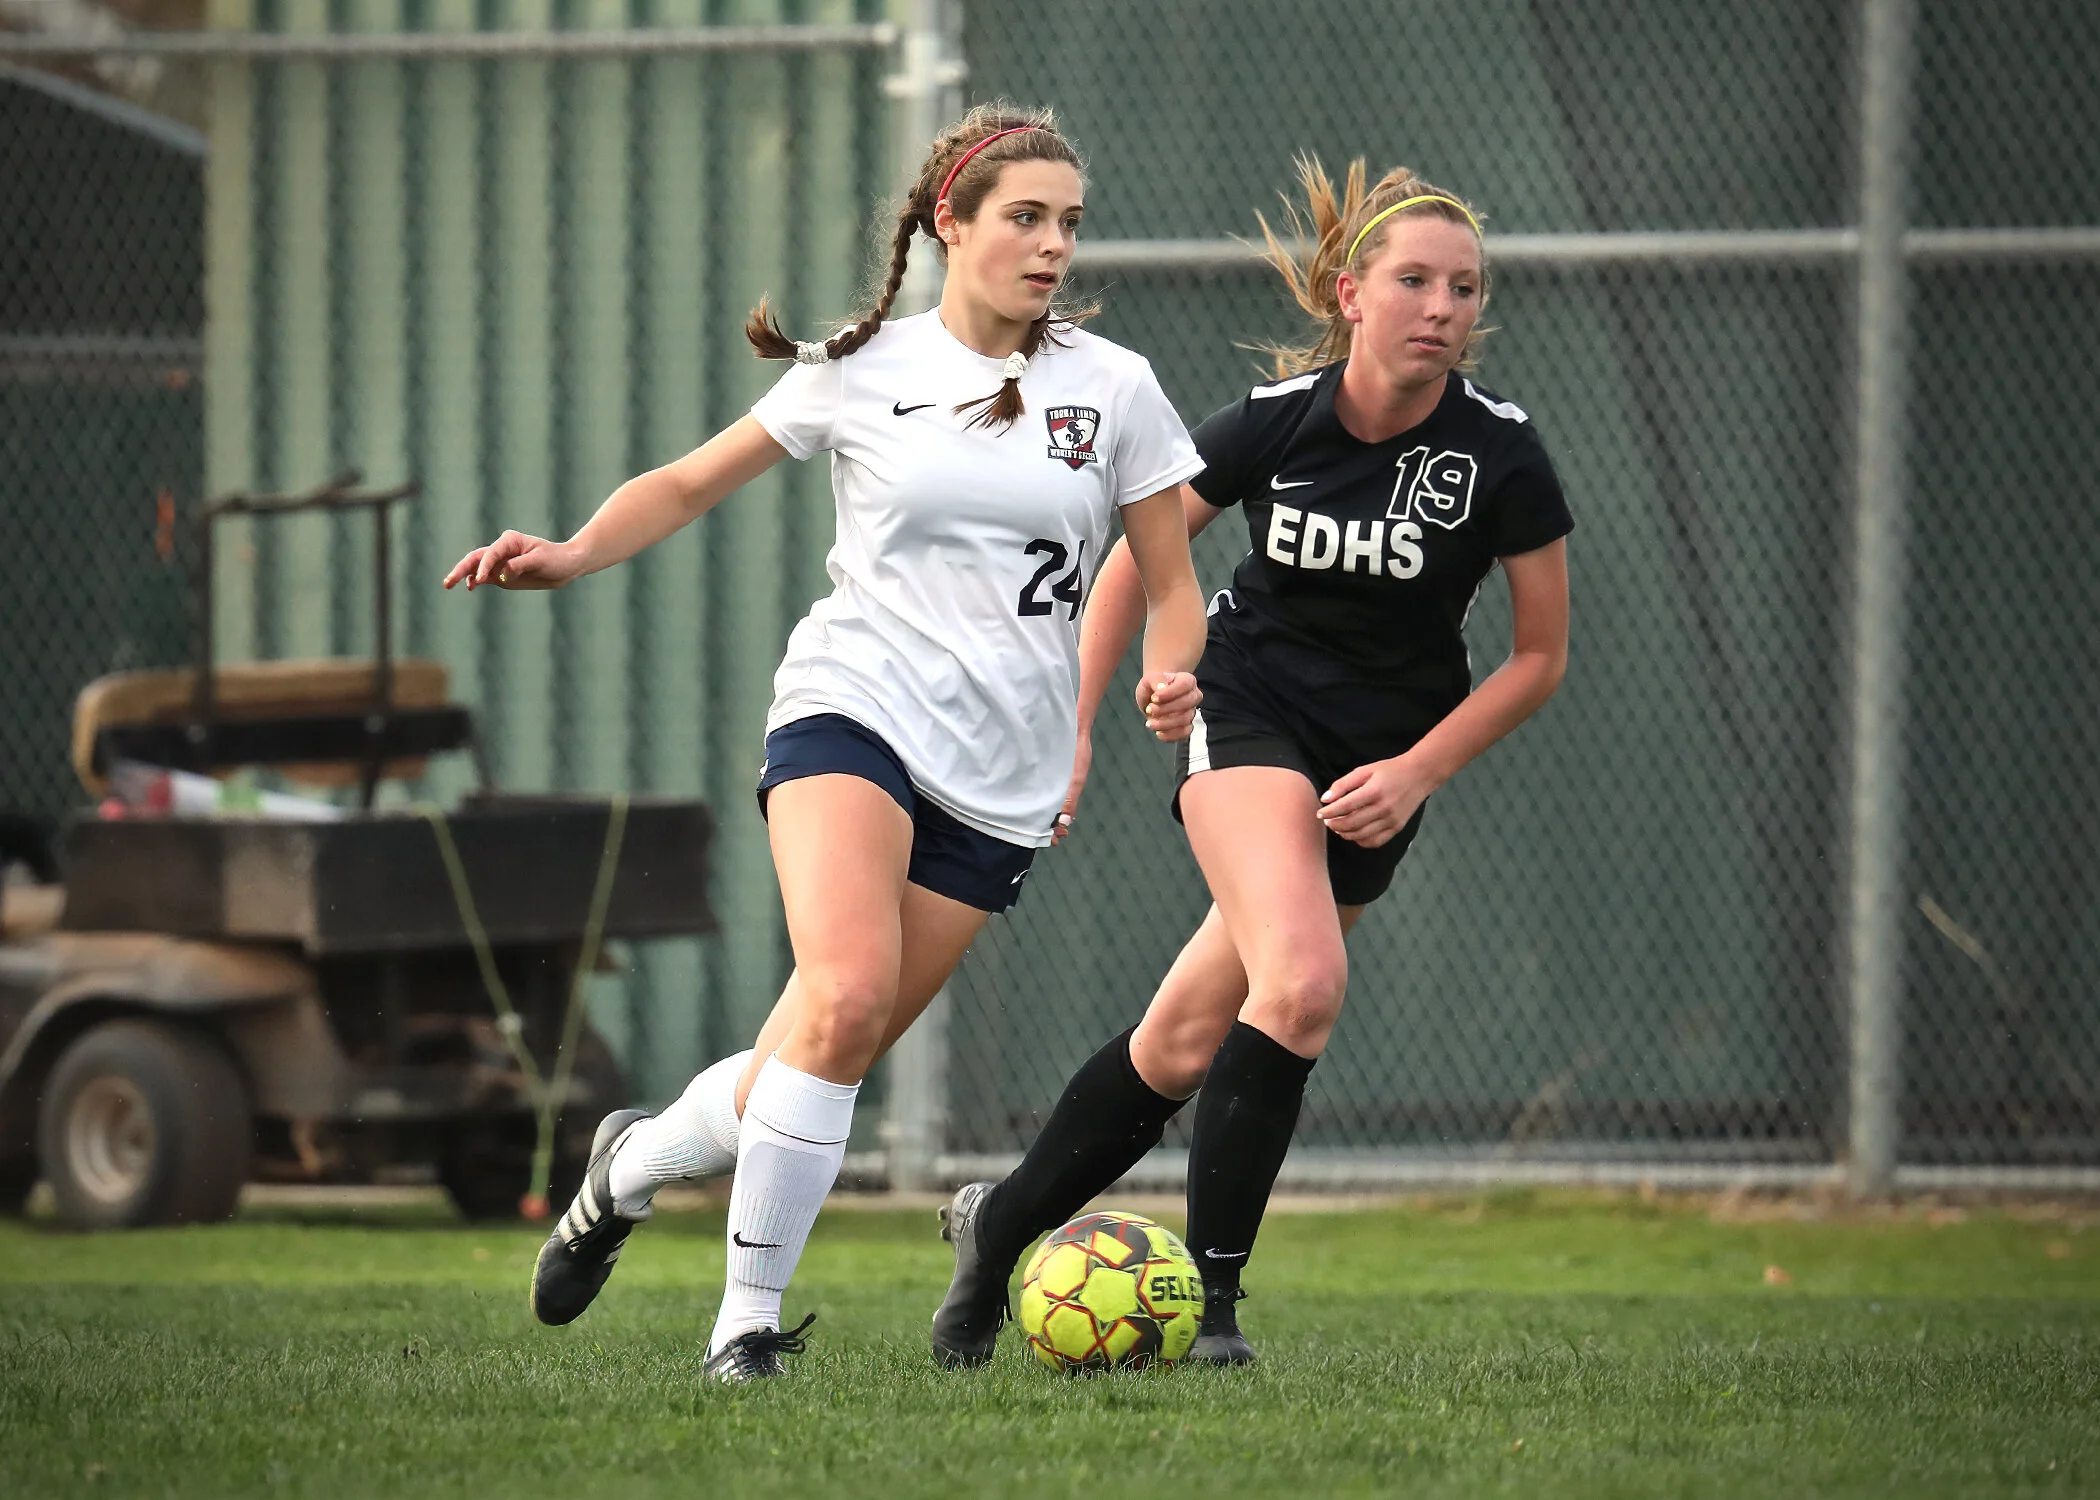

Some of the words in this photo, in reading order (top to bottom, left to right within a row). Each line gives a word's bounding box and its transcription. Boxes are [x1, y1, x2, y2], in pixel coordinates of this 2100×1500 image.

[1386, 445, 1478, 530] 19
[1018, 538, 1086, 622] 24
[1266, 502, 1424, 580] EDHS
